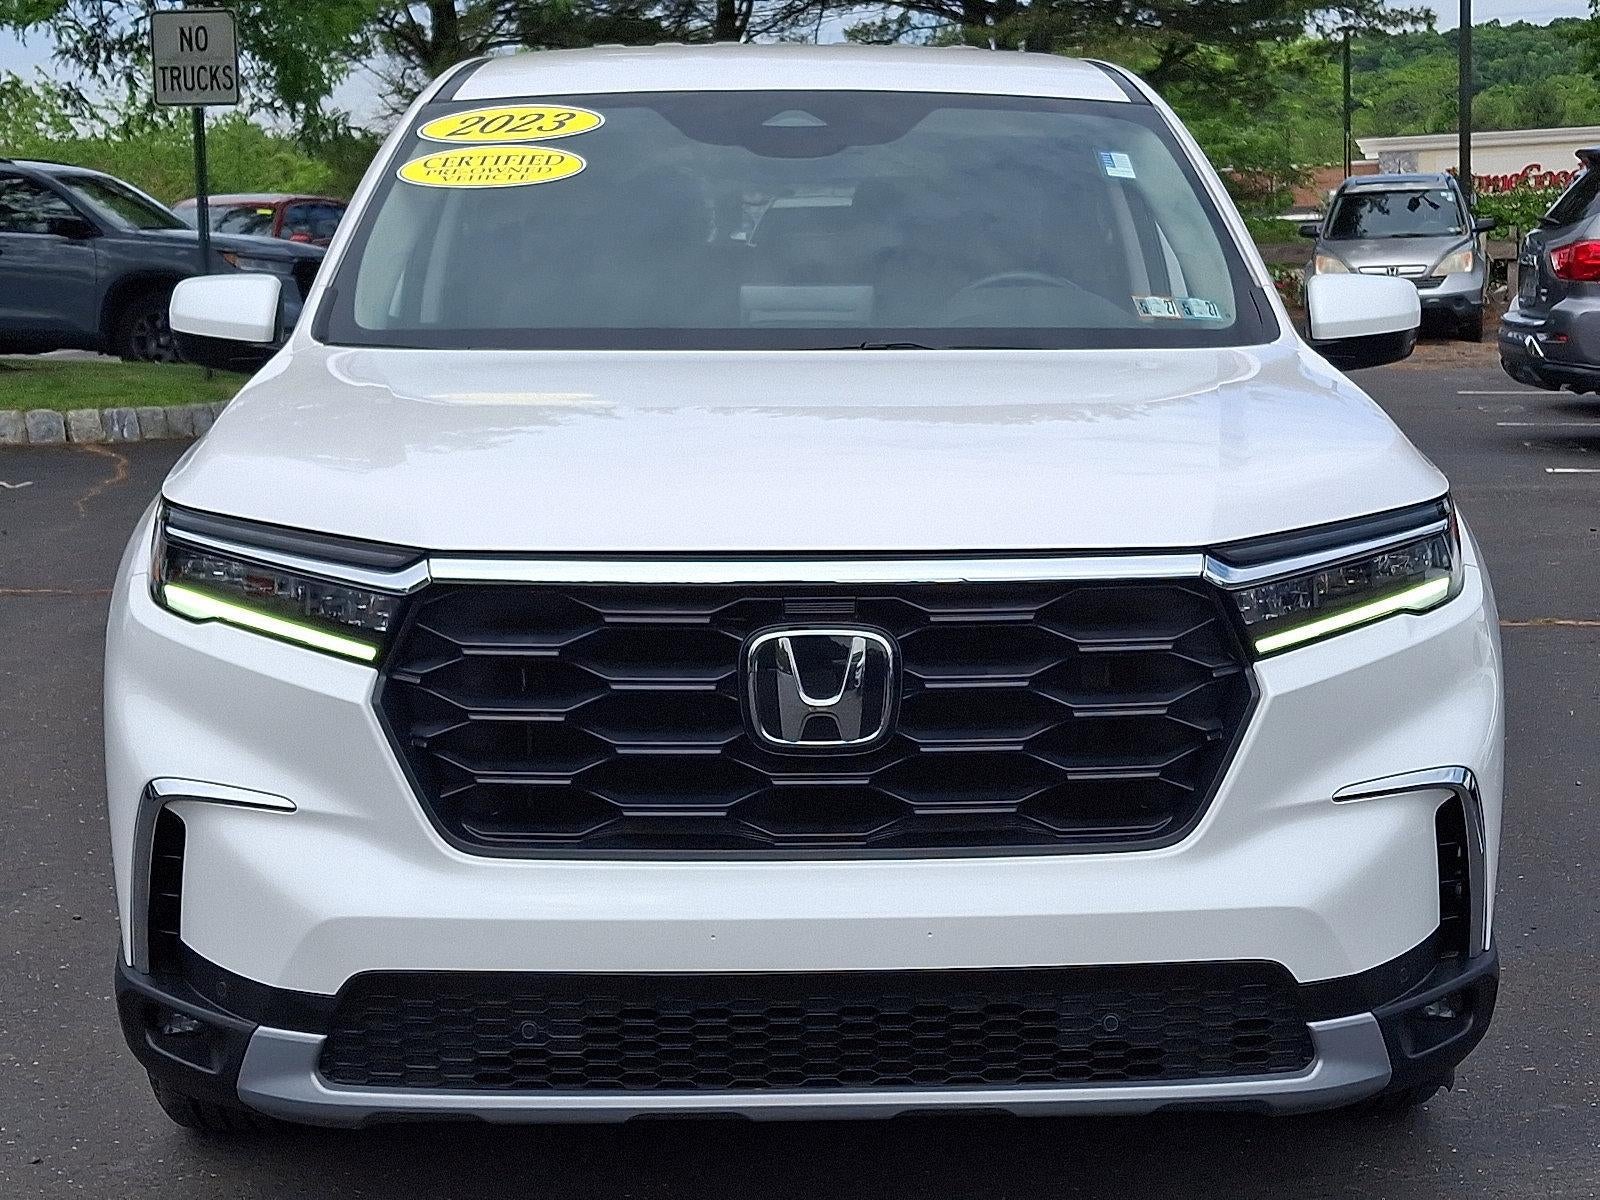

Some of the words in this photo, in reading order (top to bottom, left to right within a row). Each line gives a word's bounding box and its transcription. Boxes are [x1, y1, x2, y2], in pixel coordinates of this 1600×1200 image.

[179, 25, 208, 52] NO
[159, 65, 234, 92] TRUCKS
[446, 112, 577, 137] 2023
[423, 154, 565, 169] CERTIFIED
[426, 166, 552, 177] PRE-OWNED
[443, 174, 530, 182] VEHICLE
